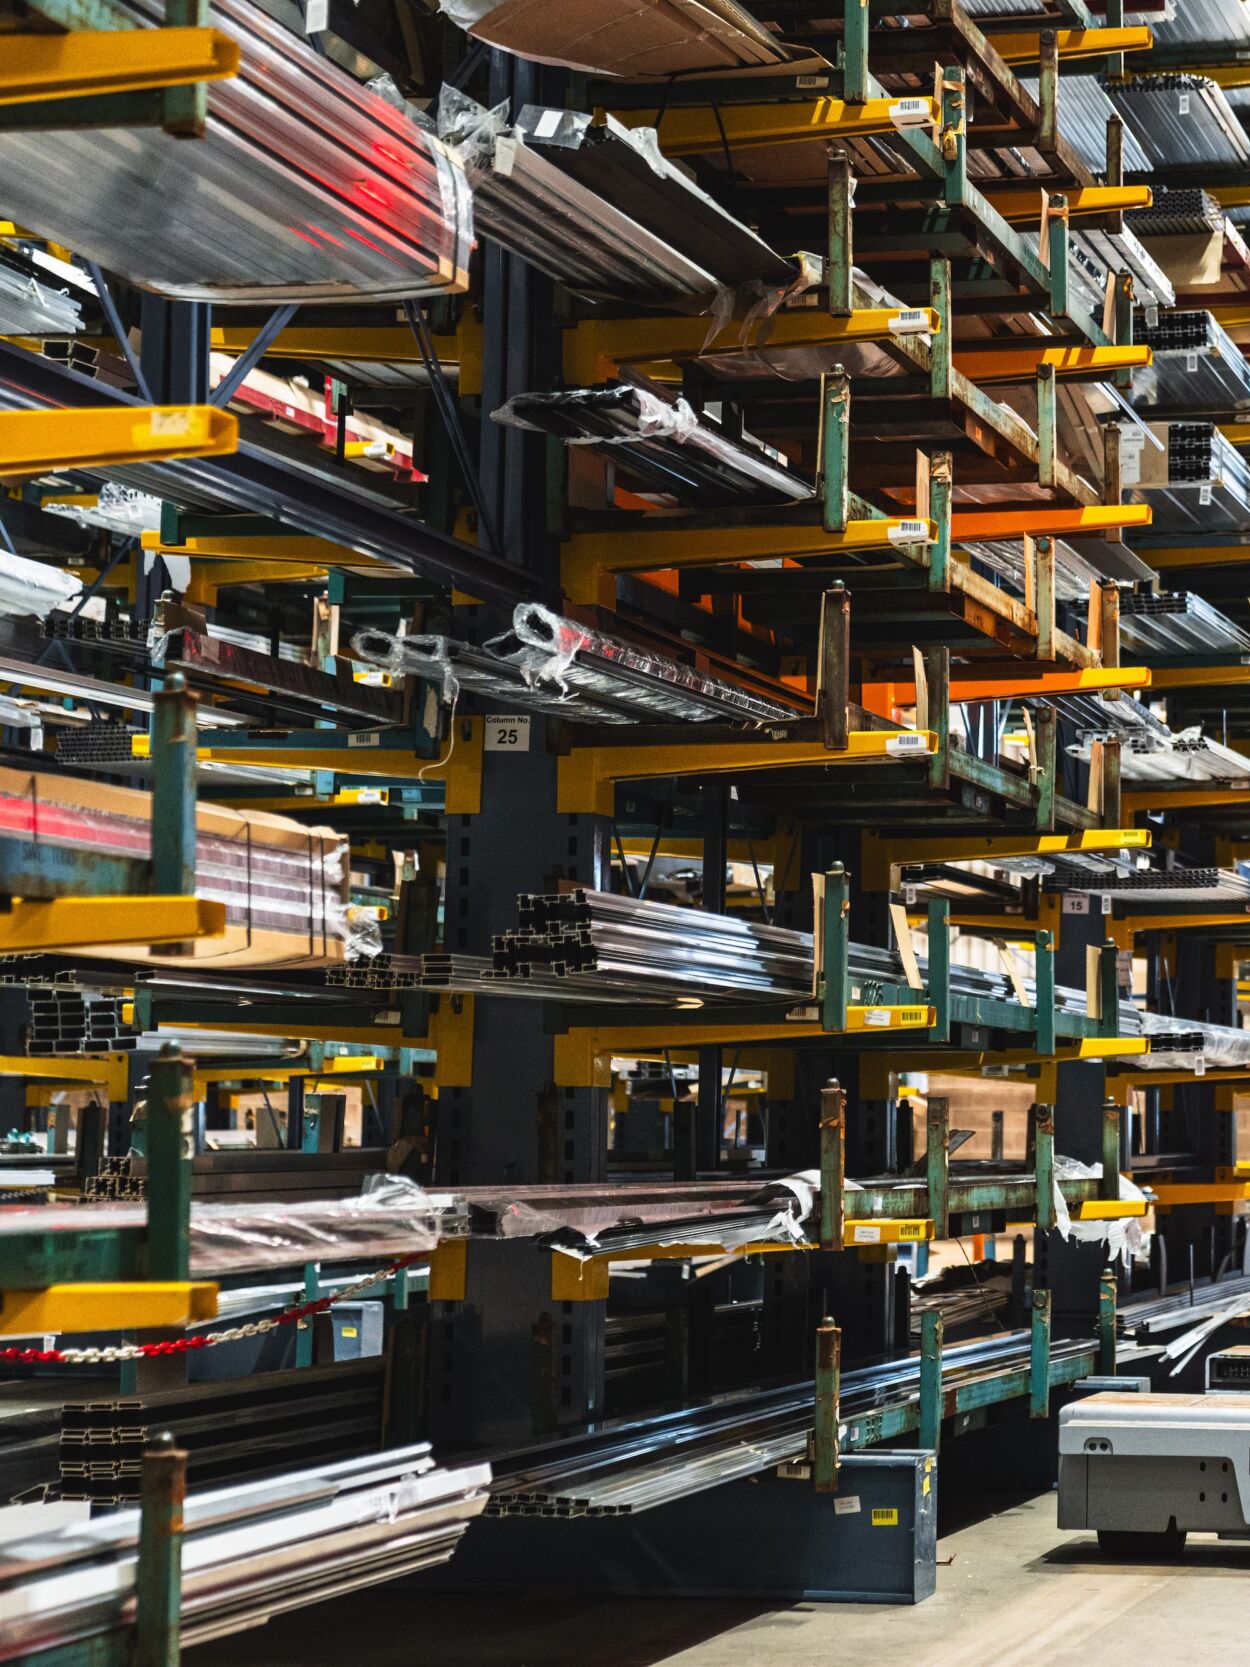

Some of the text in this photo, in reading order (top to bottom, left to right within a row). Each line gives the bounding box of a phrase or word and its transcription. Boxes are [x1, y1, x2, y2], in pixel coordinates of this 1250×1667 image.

[486, 716, 530, 724] Column No.
[497, 729, 518, 744] 25
[1071, 901, 1083, 911] 15
